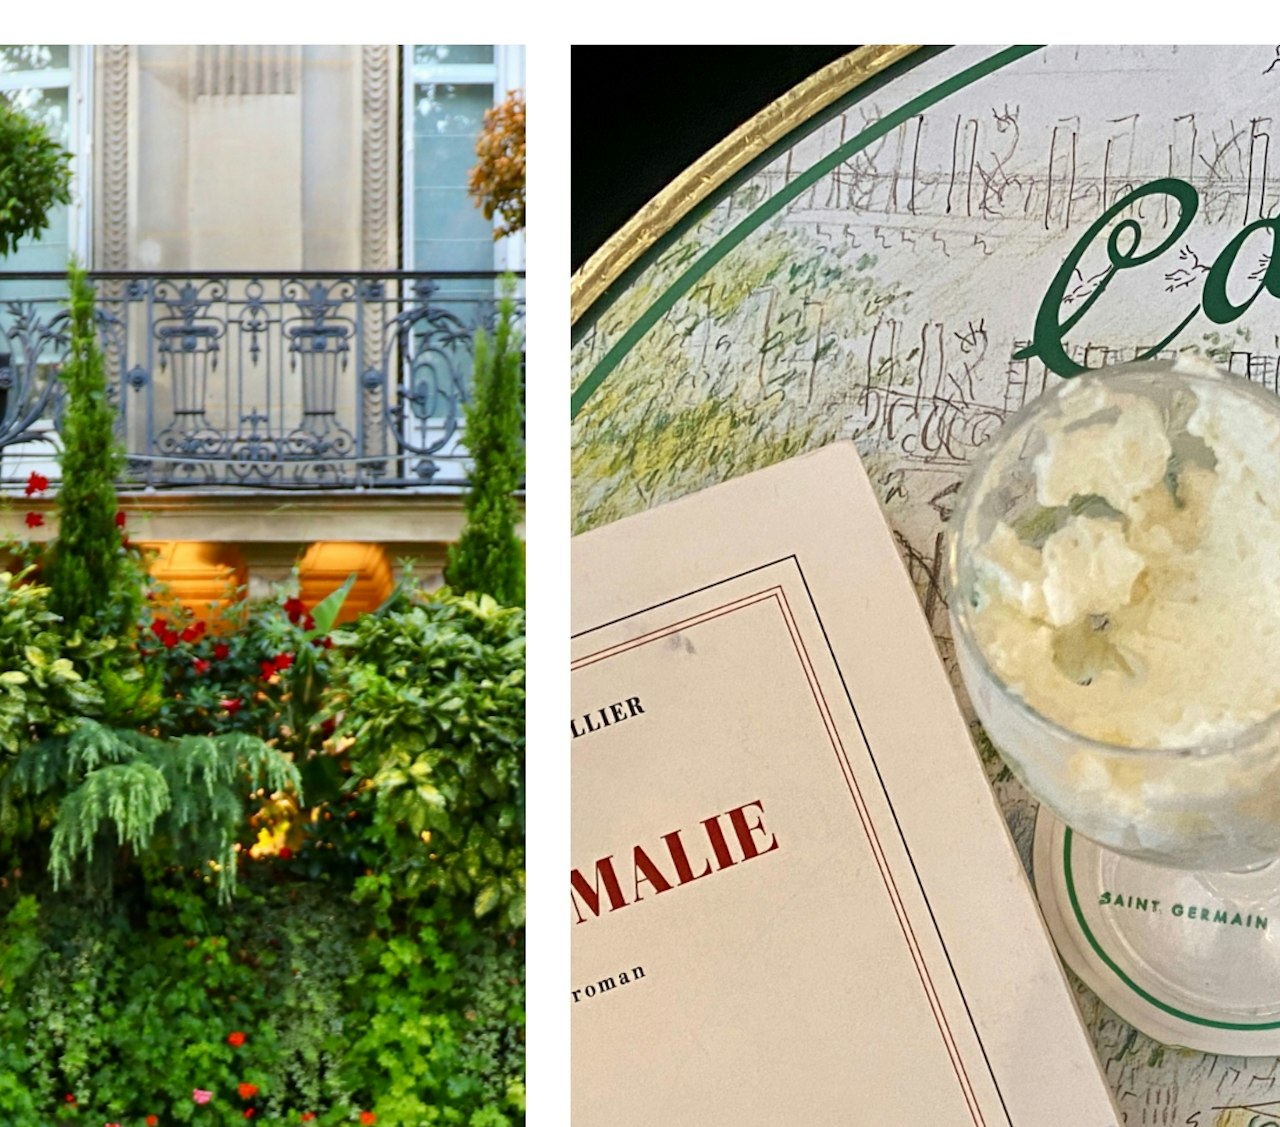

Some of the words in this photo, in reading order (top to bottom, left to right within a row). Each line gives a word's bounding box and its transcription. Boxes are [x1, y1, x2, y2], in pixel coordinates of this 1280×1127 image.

[1099, 892, 1161, 913] SAINT
[1171, 904, 1269, 931] GERMAIN
[571, 965, 646, 1003] roman
